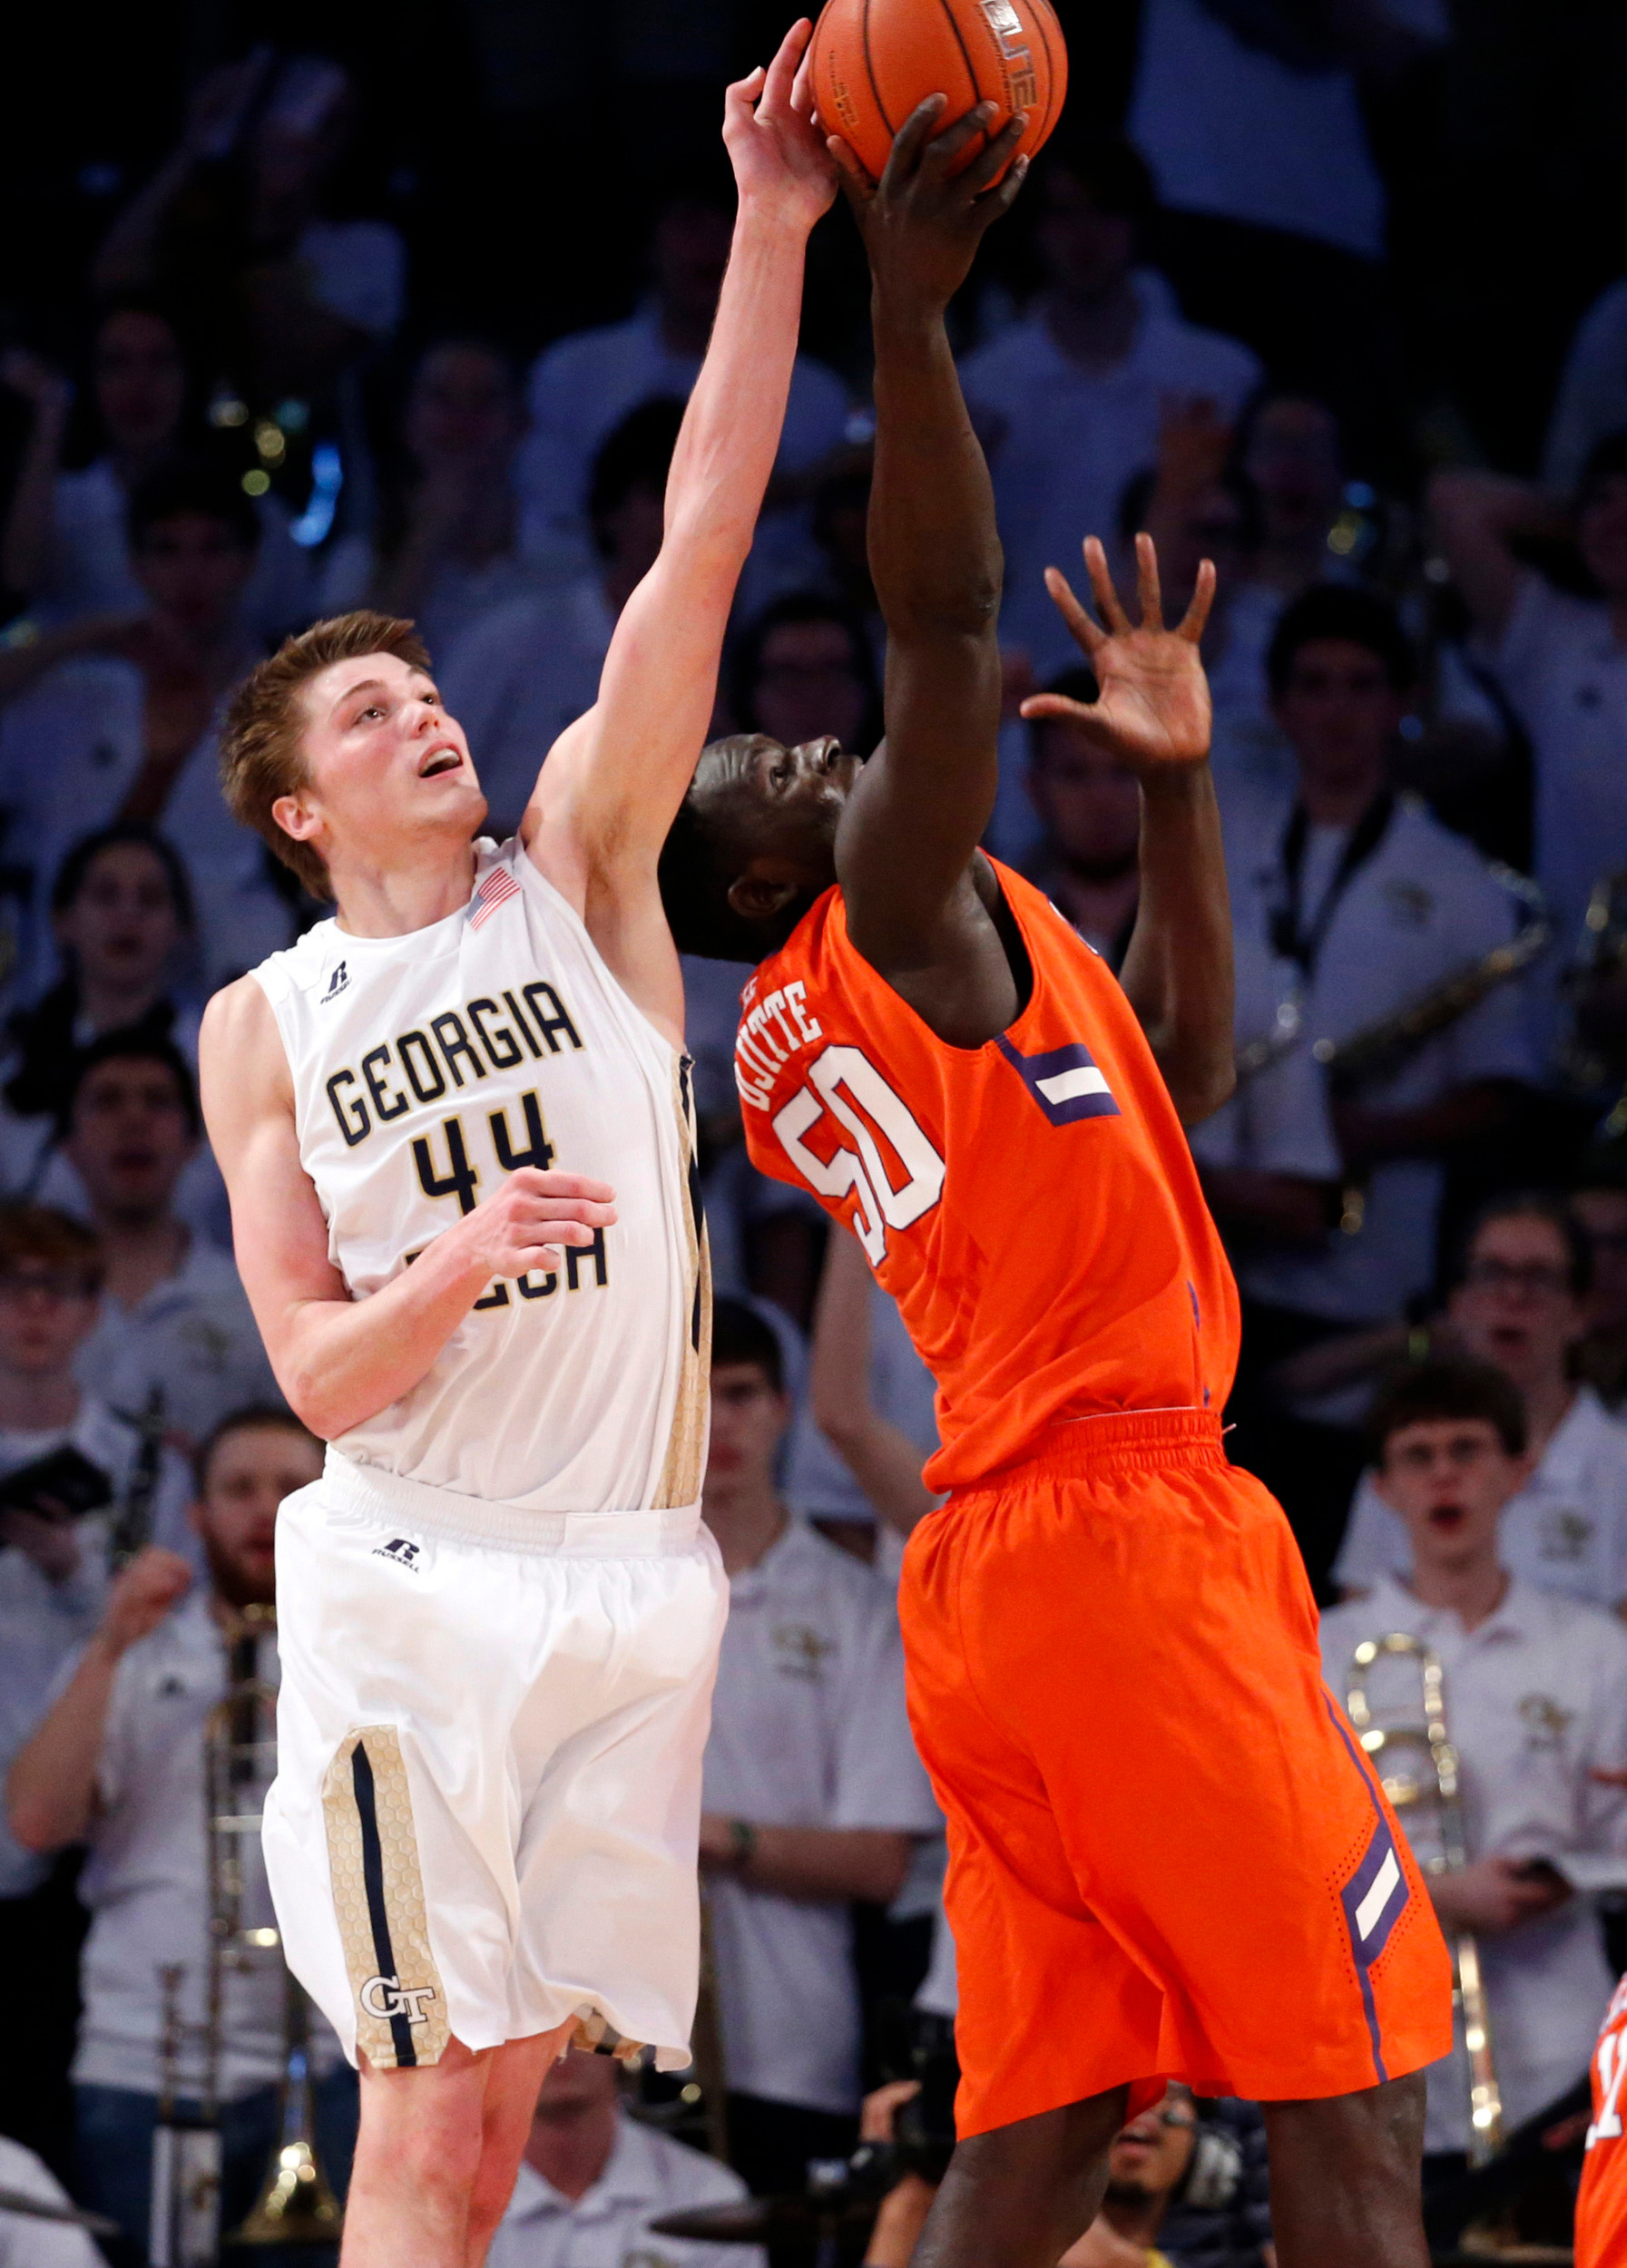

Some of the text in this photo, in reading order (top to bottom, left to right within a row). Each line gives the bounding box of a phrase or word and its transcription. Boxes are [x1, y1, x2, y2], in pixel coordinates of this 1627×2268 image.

[326, 980, 584, 1149] GEORGIA
[411, 1087, 554, 1217] 44
[771, 1043, 947, 1268] 50
[371, 1548, 420, 1574] RUSSELL
[360, 1974, 436, 2024] GT
